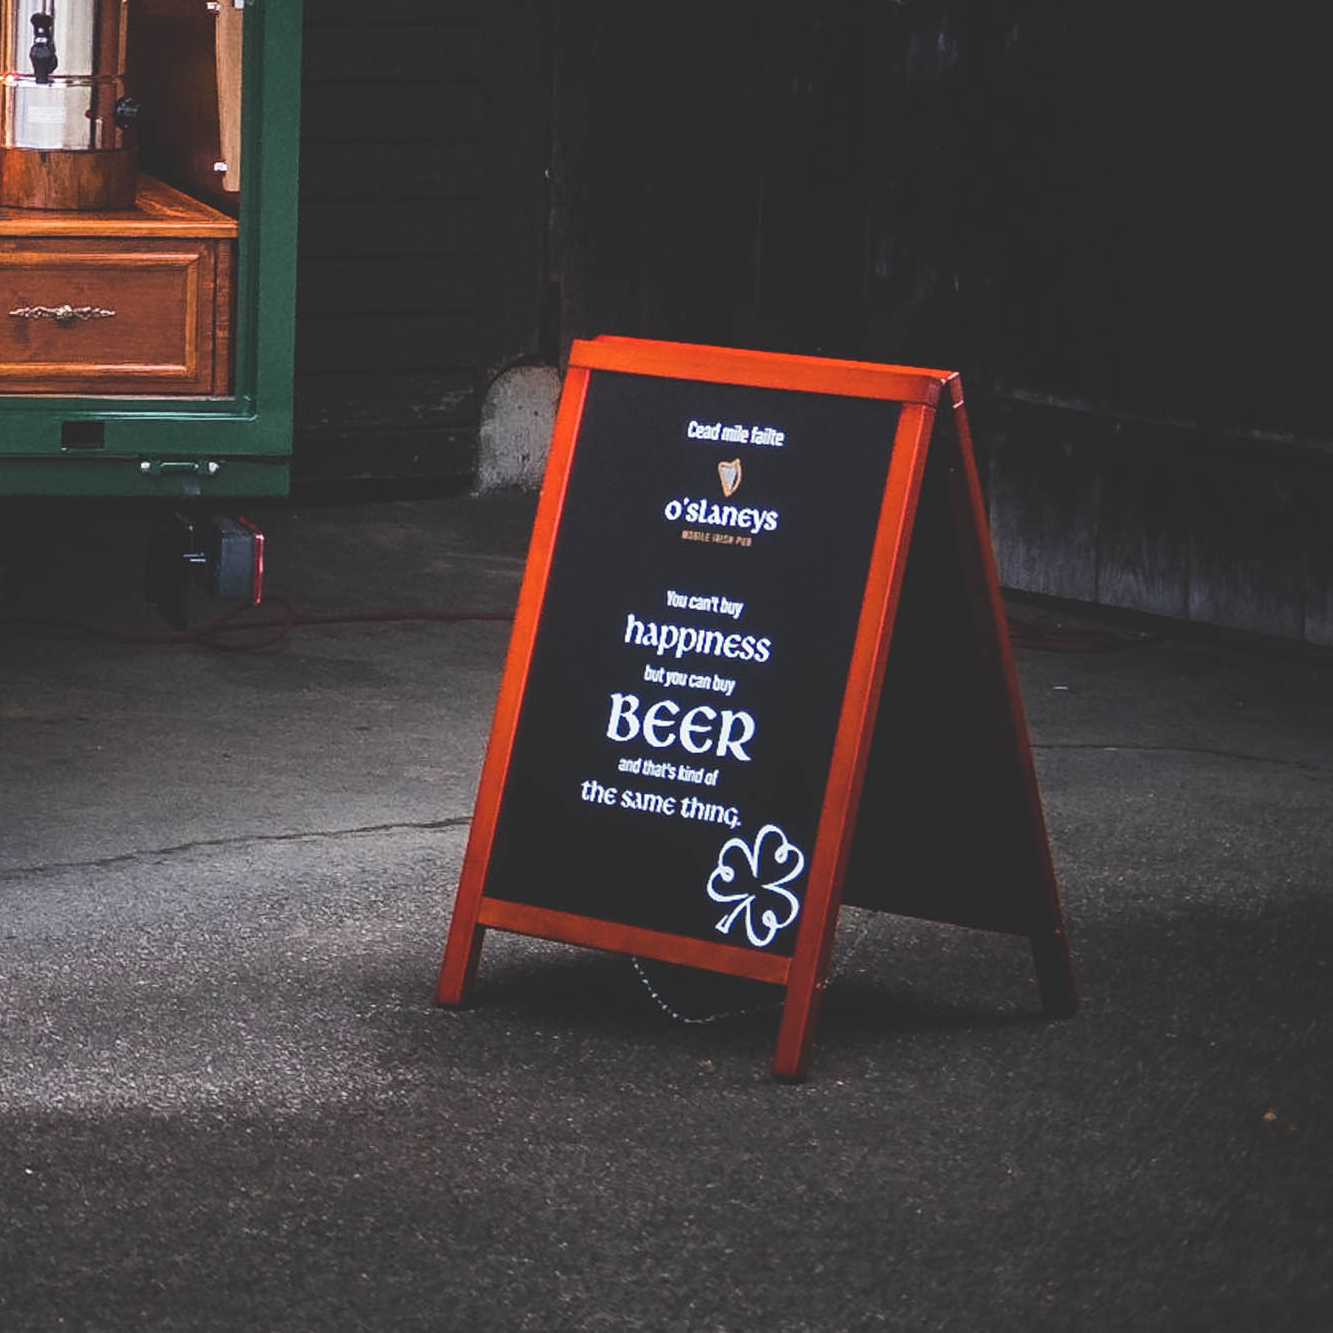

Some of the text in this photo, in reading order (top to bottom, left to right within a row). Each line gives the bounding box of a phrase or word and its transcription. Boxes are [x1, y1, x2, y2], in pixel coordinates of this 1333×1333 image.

[687, 420, 785, 446] Cead mile failte
[664, 497, 779, 534] o'slaneys
[666, 590, 744, 620] You can't buy
[624, 613, 772, 663] happiness
[643, 664, 736, 697] but you can buy
[606, 692, 756, 762] BEER
[617, 757, 720, 787] and that's kind of
[580, 779, 742, 829] the same thing.
